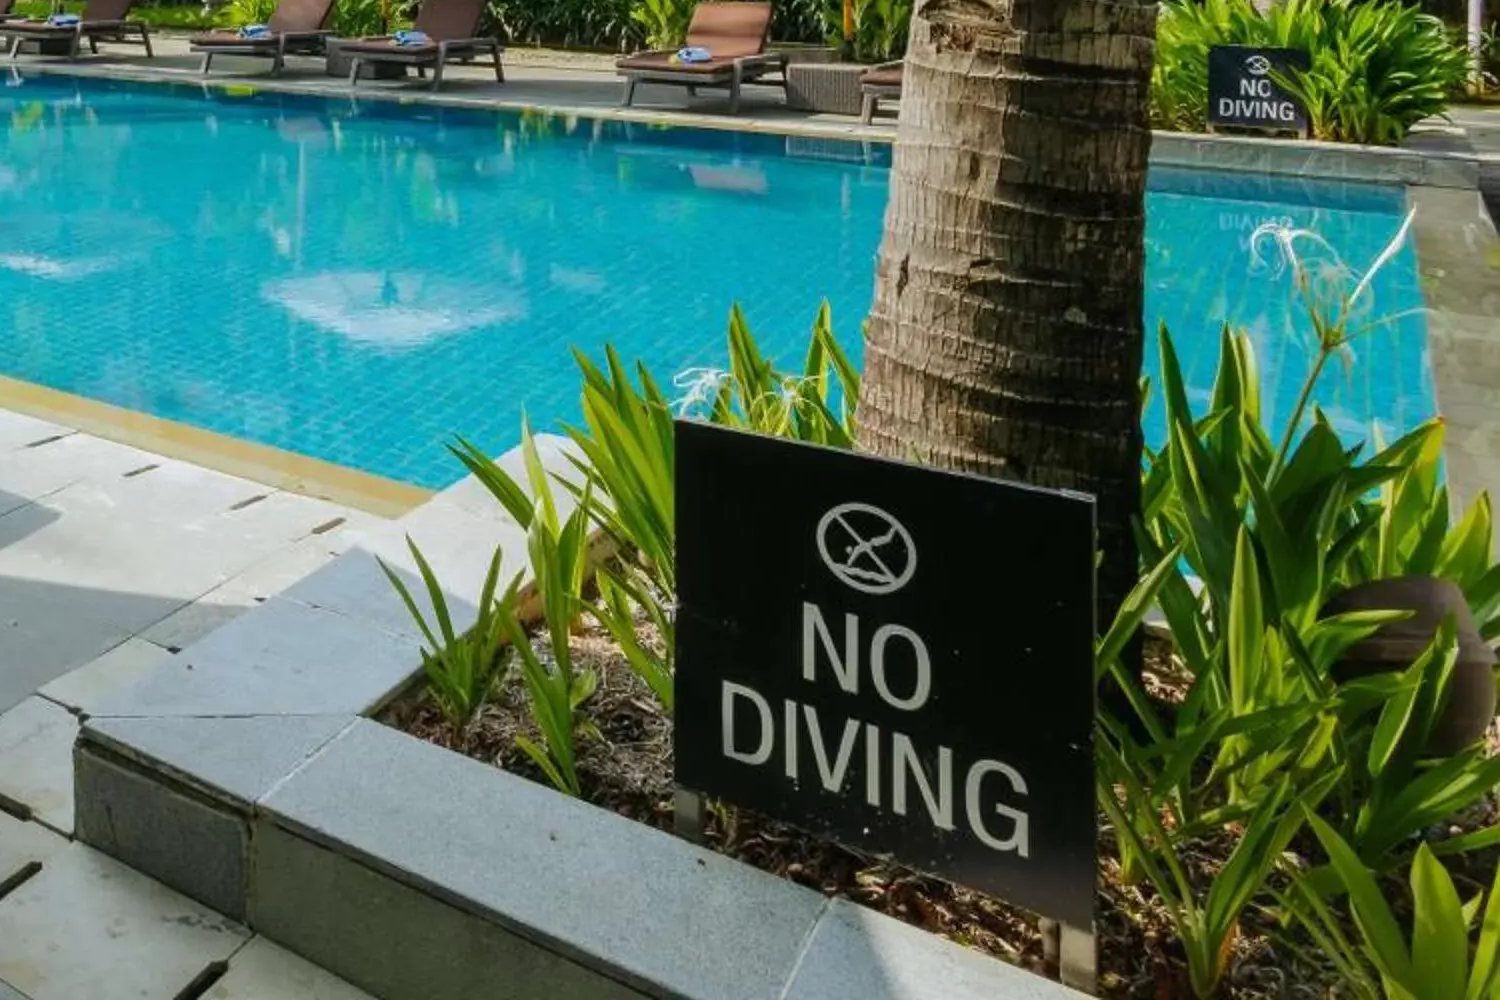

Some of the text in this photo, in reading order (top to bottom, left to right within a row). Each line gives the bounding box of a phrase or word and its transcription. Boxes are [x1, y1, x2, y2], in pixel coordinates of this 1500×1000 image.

[1219, 97, 1295, 121] DIVING
[803, 601, 931, 711] NO
[722, 680, 1030, 858] DIVING
